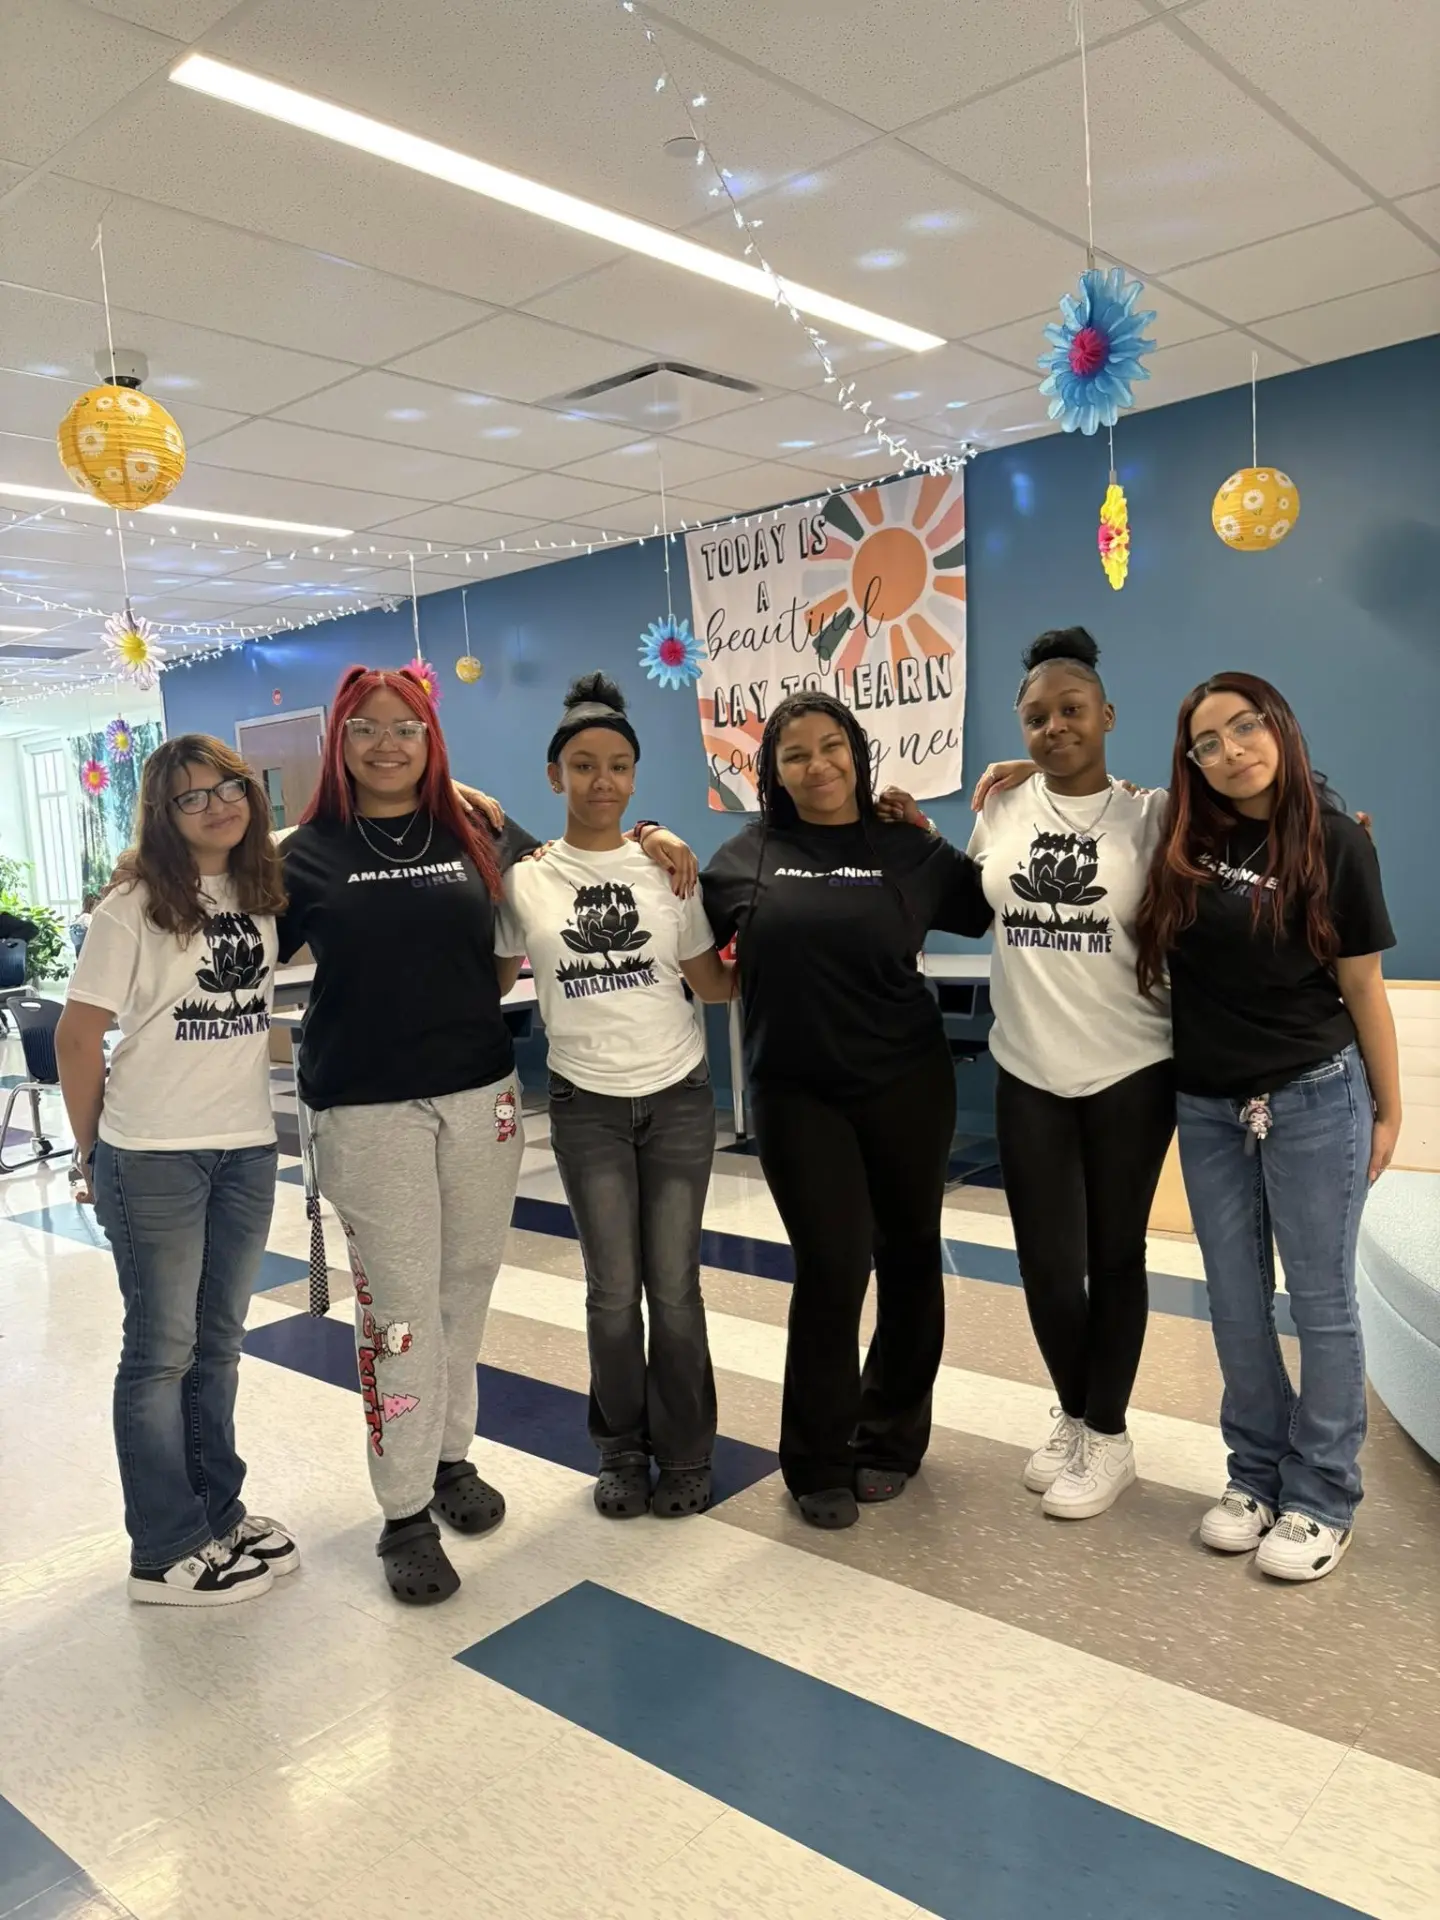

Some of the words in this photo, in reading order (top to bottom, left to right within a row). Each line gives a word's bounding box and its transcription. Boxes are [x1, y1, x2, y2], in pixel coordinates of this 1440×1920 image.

[701, 523, 786, 581] TODAY
[799, 514, 828, 560] IS
[756, 580, 770, 613] A
[706, 575, 885, 676] beautiful
[714, 680, 768, 728] DAY
[834, 653, 953, 711] LEARN
[347, 861, 465, 884] AMAZINNME
[410, 872, 468, 889] GIRLS
[1006, 927, 1082, 952] AMAZINN
[1088, 933, 1113, 953] ME
[563, 972, 640, 999] AMAZINN
[638, 968, 659, 987] ME
[359, 1347, 384, 1457] KITTY
